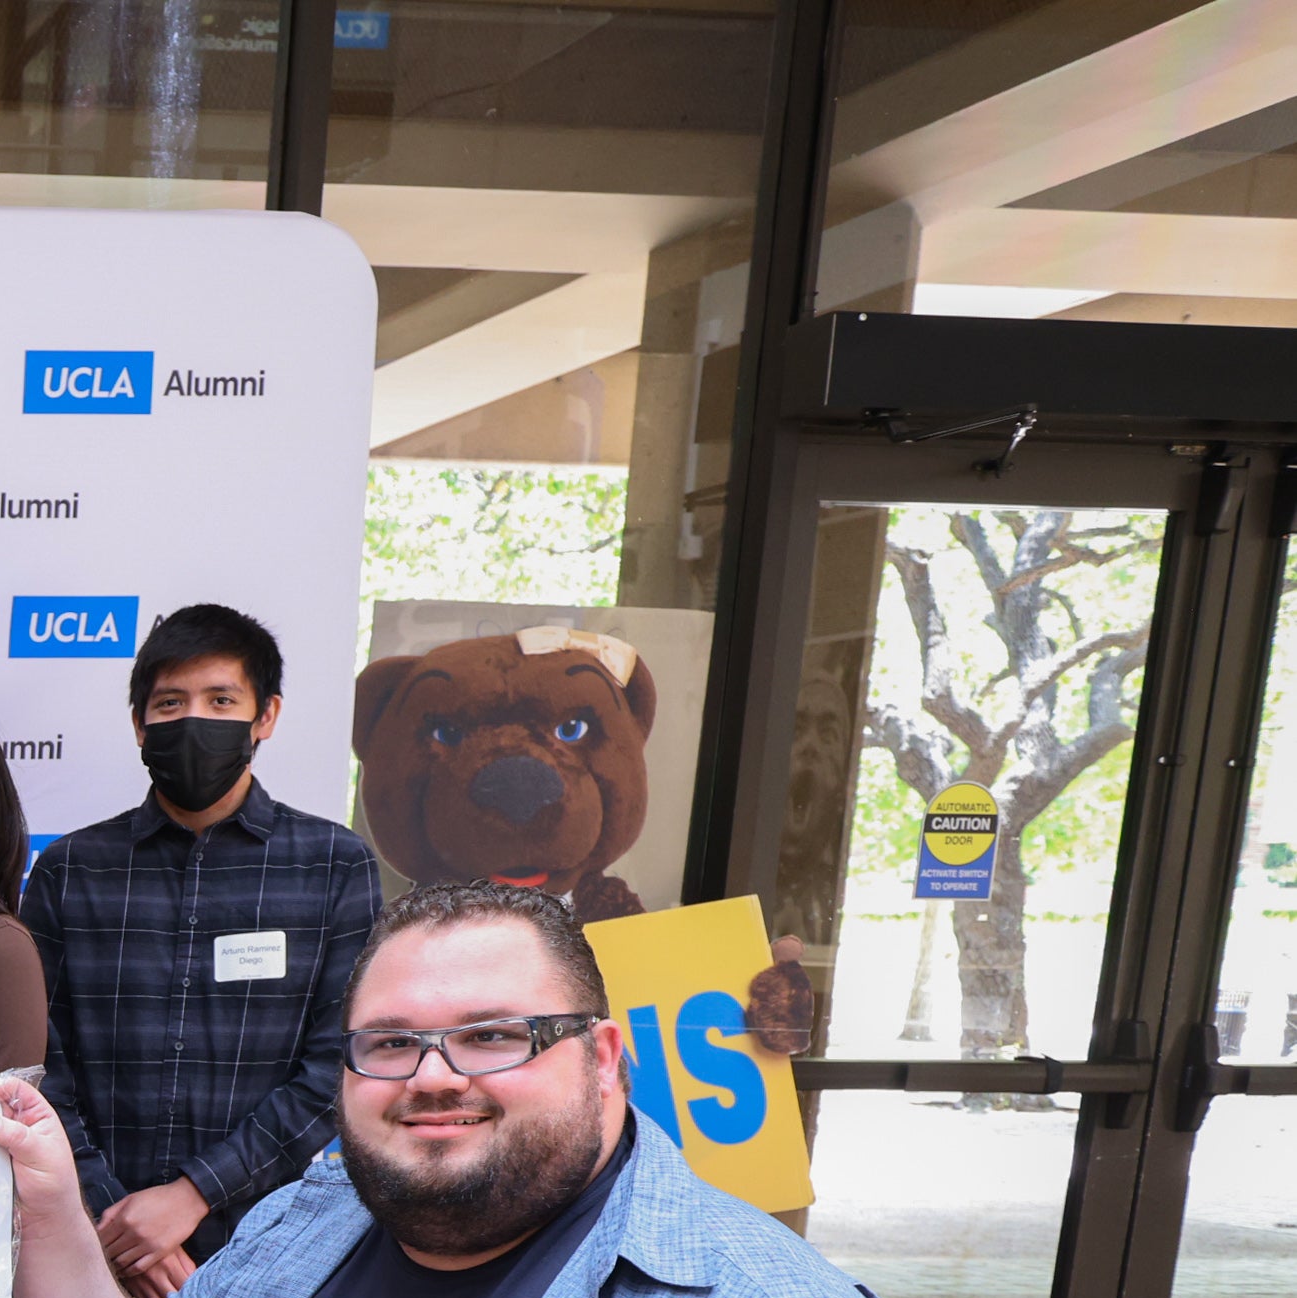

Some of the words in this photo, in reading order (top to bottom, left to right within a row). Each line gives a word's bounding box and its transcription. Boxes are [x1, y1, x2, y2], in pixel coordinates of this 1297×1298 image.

[42, 366, 135, 399] UCLA
[163, 370, 265, 397] Alumni
[28, 611, 120, 643] UCLA
[936, 803, 991, 813] AUTOMATIC
[931, 817, 992, 831] CAUTION
[945, 836, 973, 846] DOOR
[920, 869, 957, 878] ACTIVATE
[958, 870, 989, 878] SWITCH
[930, 882, 942, 890] TO
[942, 882, 979, 891] OPERATE
[623, 990, 768, 1150] NS
